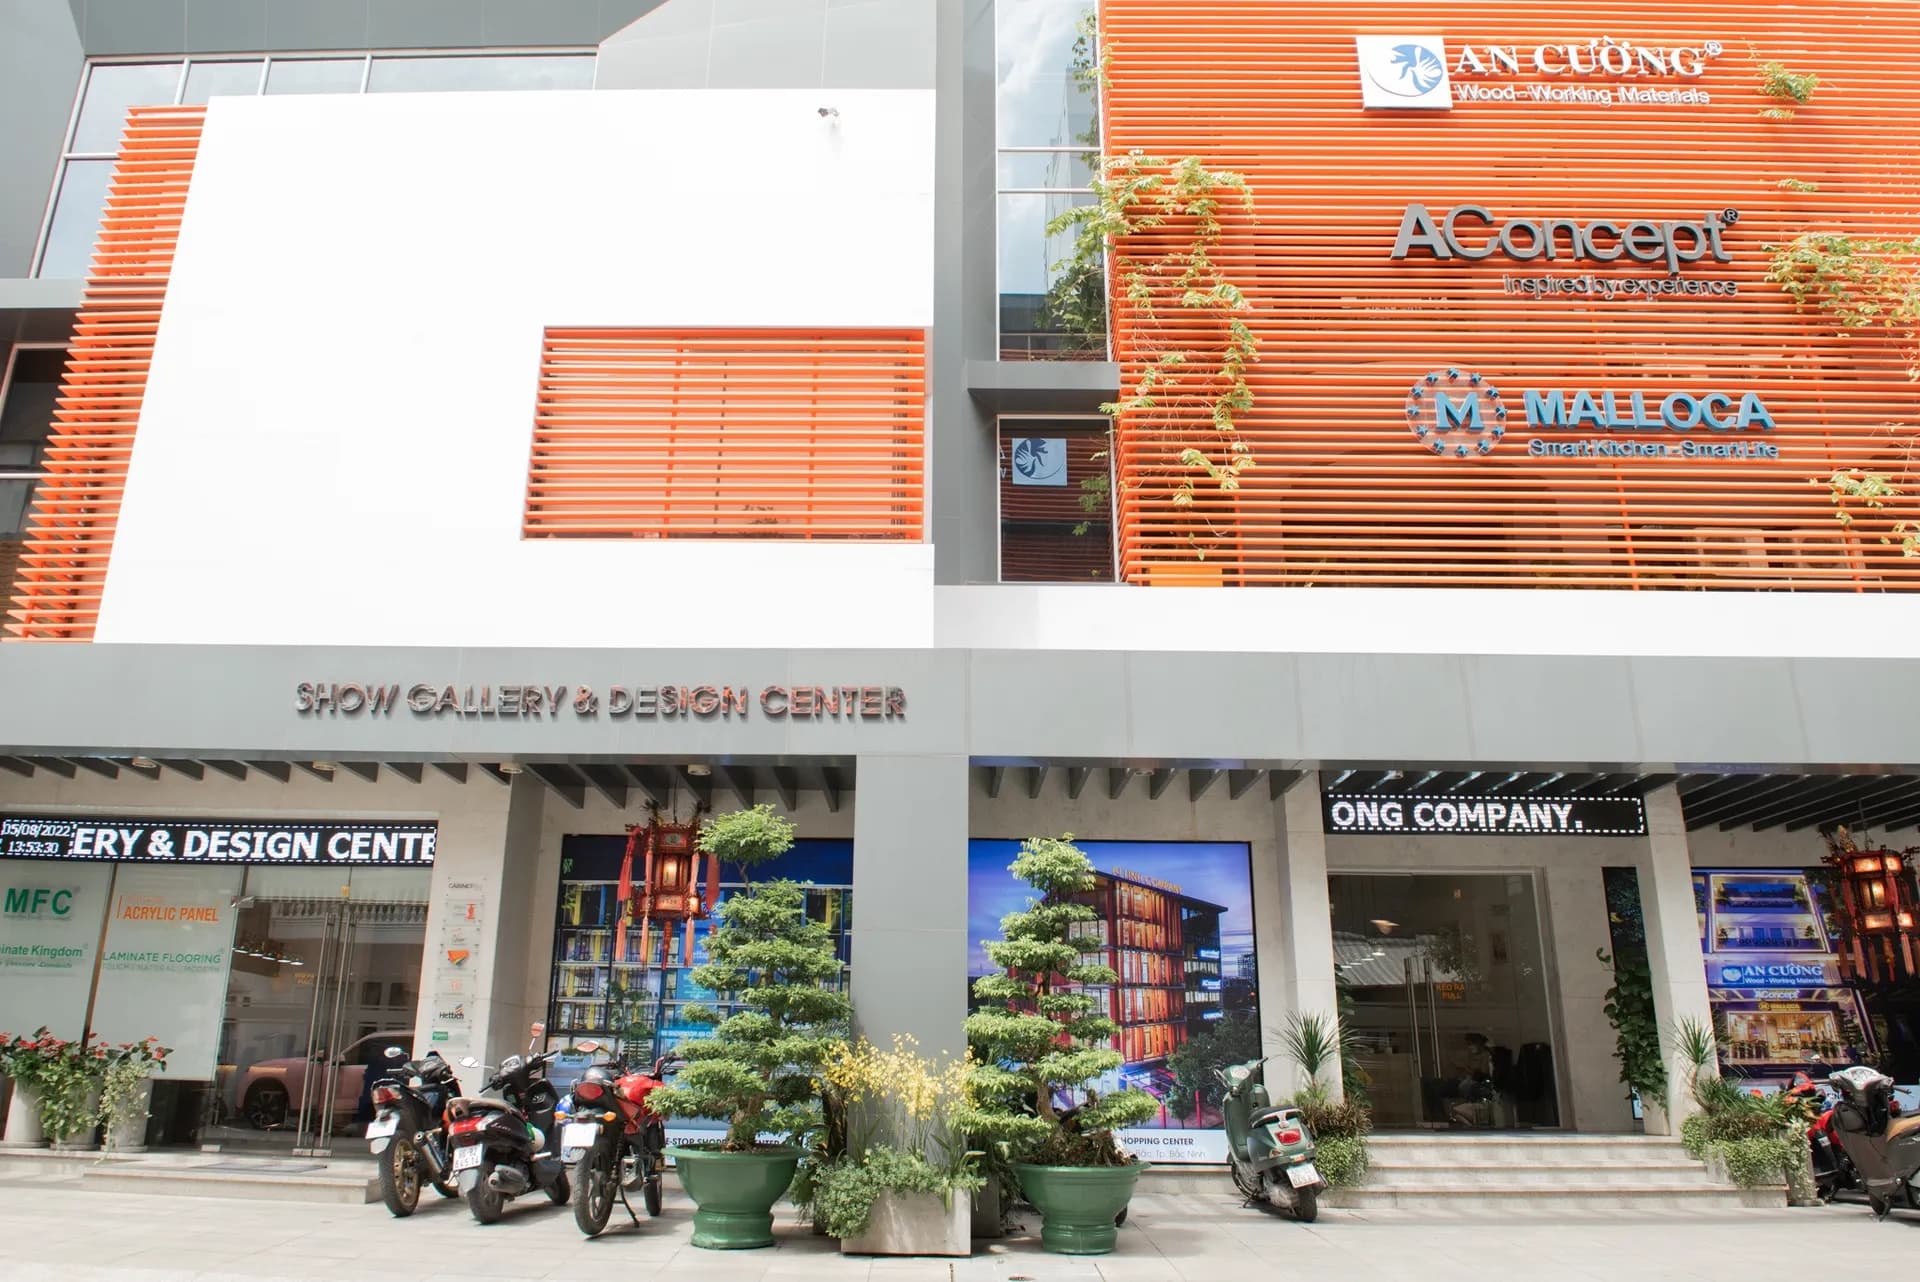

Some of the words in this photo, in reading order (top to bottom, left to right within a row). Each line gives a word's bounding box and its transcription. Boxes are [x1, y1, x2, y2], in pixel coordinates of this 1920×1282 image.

[1454, 44, 1520, 75] AN
[1617, 86, 1711, 105] Materials
[1391, 203, 1733, 276] AConcept
[1502, 274, 1590, 299] Inspired
[1591, 275, 1619, 298] by
[1620, 277, 1738, 301] experience
[1522, 390, 1776, 432] MALLOCA
[1528, 439, 1590, 458] Smart
[1590, 440, 1668, 458] Kitchen
[1680, 440, 1742, 458] Smart
[296, 681, 400, 716] SHOW
[406, 682, 568, 717] GALLERY
[573, 684, 600, 717] &
[608, 684, 749, 718] DESIGN
[759, 684, 907, 718] CENTER
[1331, 800, 1402, 827] ONG
[1413, 801, 1583, 830] COMPANY.
[73, 827, 144, 857] ERY
[148, 830, 176, 857] &
[183, 830, 318, 860] DESIGN
[4, 887, 73, 916] MFC
[123, 905, 176, 922] ACRYLIC
[179, 906, 220, 922] PANEL
[0, 944, 28, 956] inate
[30, 944, 83, 959] Kingdom
[103, 951, 159, 963] LAMINATE
[162, 953, 222, 965] FLOORING
[1744, 965, 1766, 976] AN
[1121, 1137, 1160, 1145] HOPPING
[1162, 1138, 1194, 1146] CENTER
